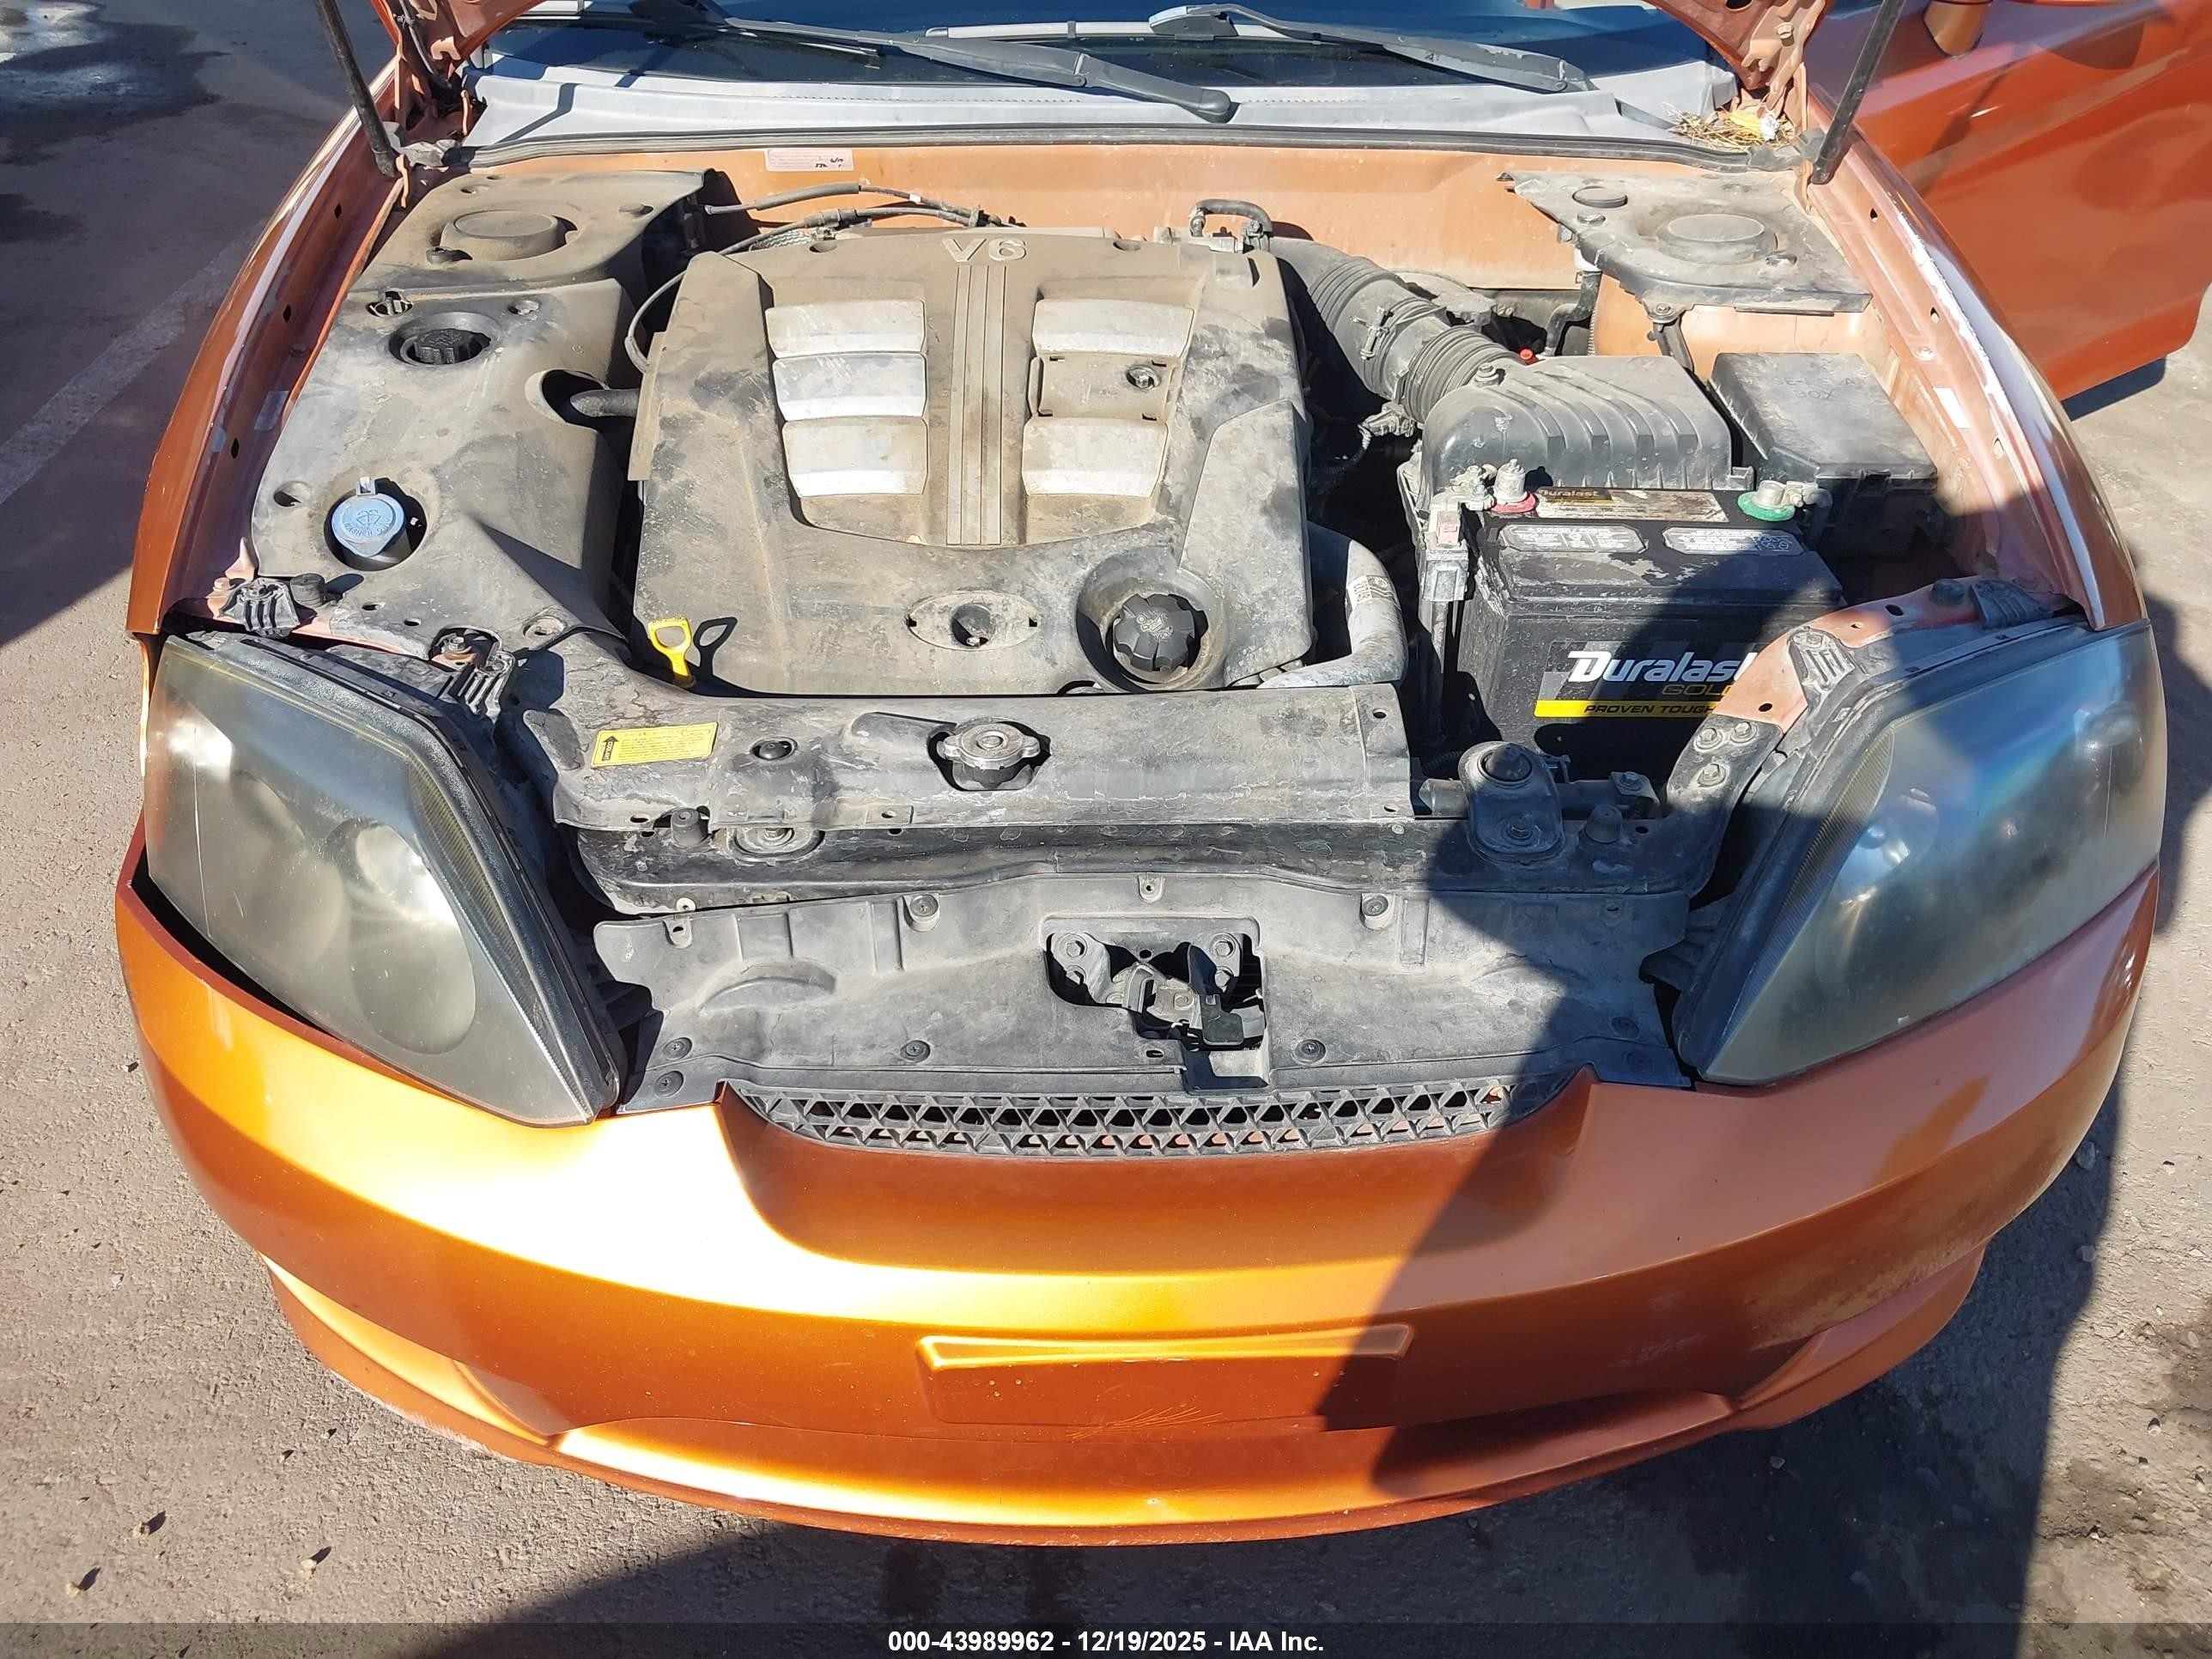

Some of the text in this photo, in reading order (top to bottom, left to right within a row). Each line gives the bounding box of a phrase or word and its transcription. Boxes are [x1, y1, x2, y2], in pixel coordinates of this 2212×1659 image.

[942, 237, 1028, 263] V6
[1584, 705, 1717, 714] PROVEN TOUGH
